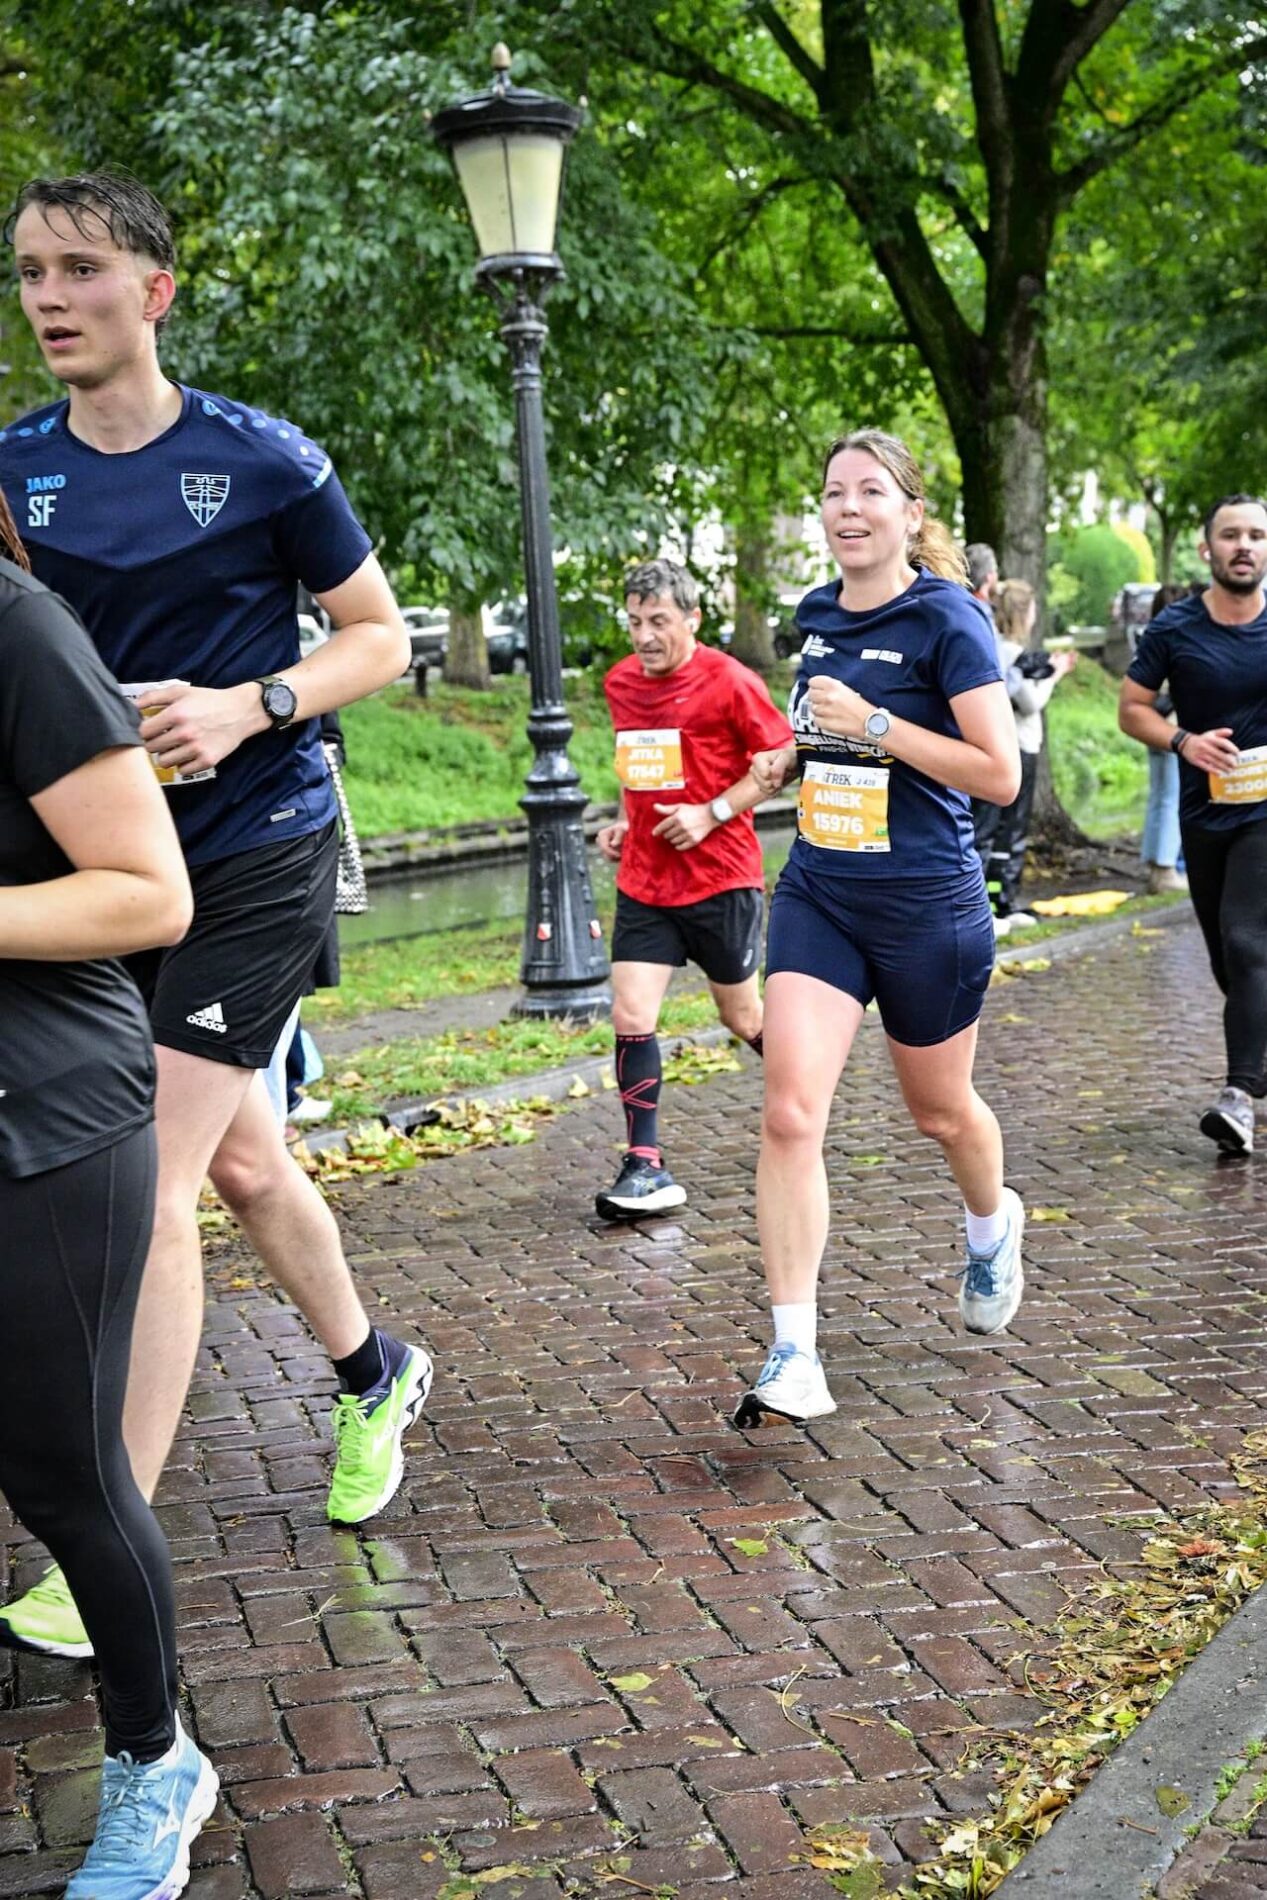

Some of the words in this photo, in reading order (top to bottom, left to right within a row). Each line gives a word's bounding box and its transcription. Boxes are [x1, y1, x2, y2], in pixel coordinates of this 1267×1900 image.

[26, 474, 66, 493] JAKO
[28, 495, 57, 527] SF
[824, 772, 852, 786] TREK
[1224, 779, 1267, 794] 2300
[813, 788, 864, 810] ANIEK
[812, 811, 865, 836] 15976
[186, 1014, 228, 1034] adidas
